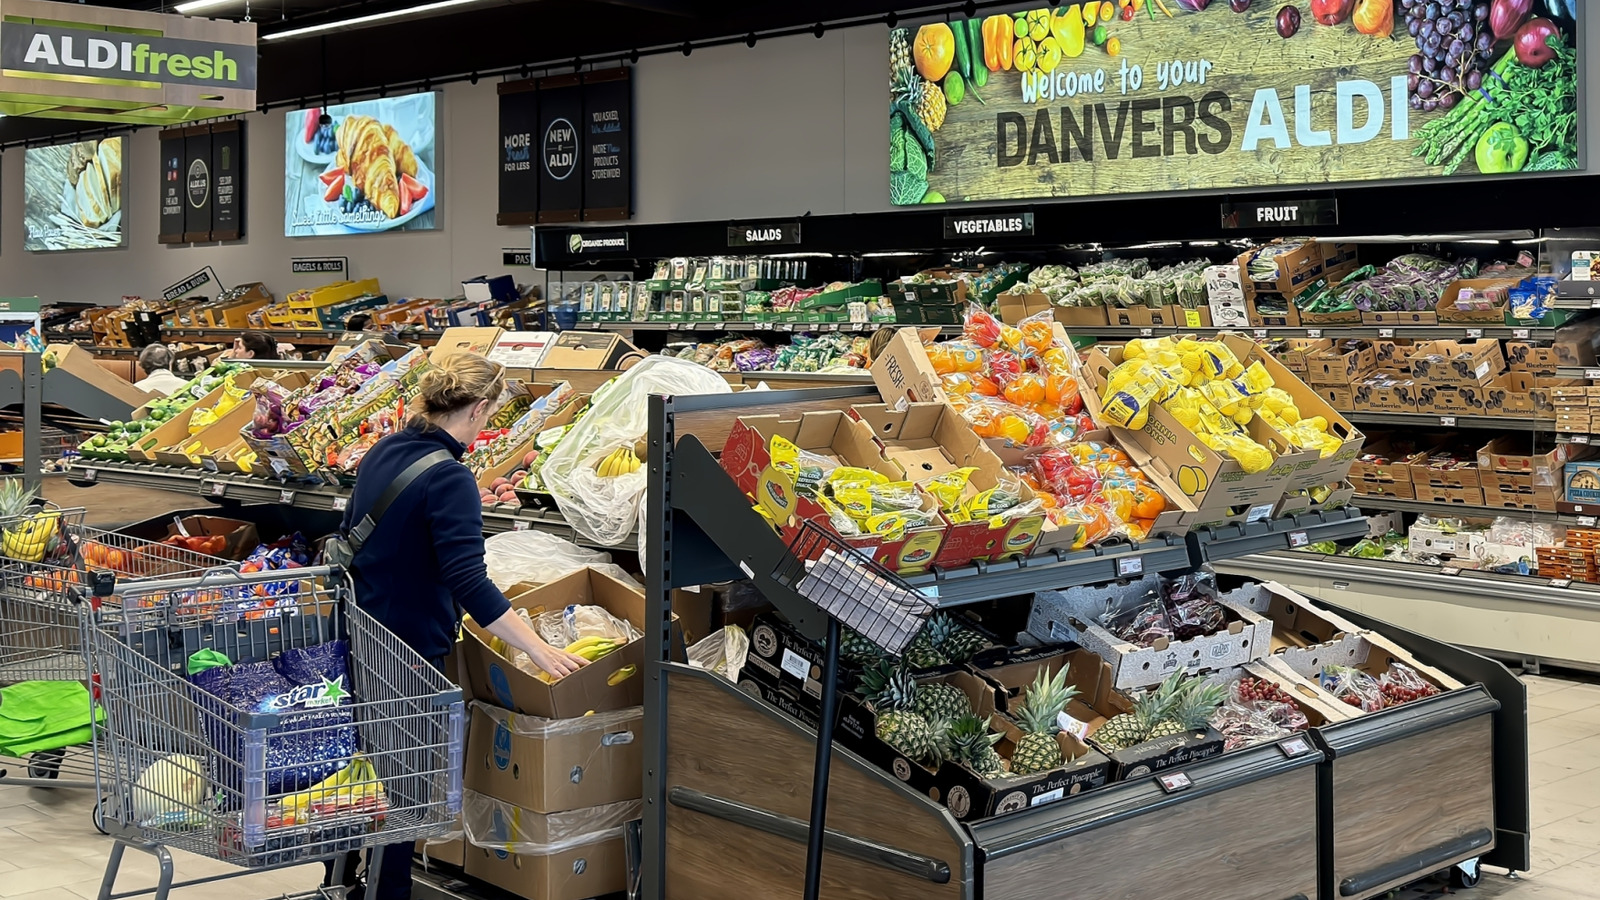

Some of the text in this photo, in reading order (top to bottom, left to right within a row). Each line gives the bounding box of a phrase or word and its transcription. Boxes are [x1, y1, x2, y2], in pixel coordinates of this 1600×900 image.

[1021, 58, 1212, 104] Welcome to your
[592, 112, 602, 122] YOU
[997, 75, 1410, 167] DANVERS ALDI
[504, 133, 530, 148] MORE
[550, 128, 572, 143] NEW
[592, 143, 606, 154] MORE
[504, 161, 530, 172] FOR LESS
[549, 152, 573, 167] ALDI
[593, 155, 619, 167] PRODUCTS
[340, 205, 385, 228] Somethings
[1256, 206, 1299, 222] FRUIT
[953, 218, 1023, 234] VEGETABLES
[582, 238, 625, 248] ORGANIC PRODUCE
[745, 228, 782, 242] SALADS
[293, 262, 342, 272] BAGELS & ROLLS
[165, 285, 187, 301] BREAD
[190, 273, 208, 287] BUNS
[885, 355, 905, 388] FRESH
[1502, 407, 1538, 415] Blueberries
[1144, 424, 1166, 446] ONS
[1148, 415, 1177, 445] ORNIA
[781, 634, 792, 648] The
[793, 639, 813, 660] Perfect
[274, 684, 326, 707] star
[766, 690, 778, 703] The
[779, 696, 798, 715] Perfect
[1156, 746, 1216, 768] The Perfect Pineapple
[1032, 769, 1101, 794] The Perfect Pineapple
